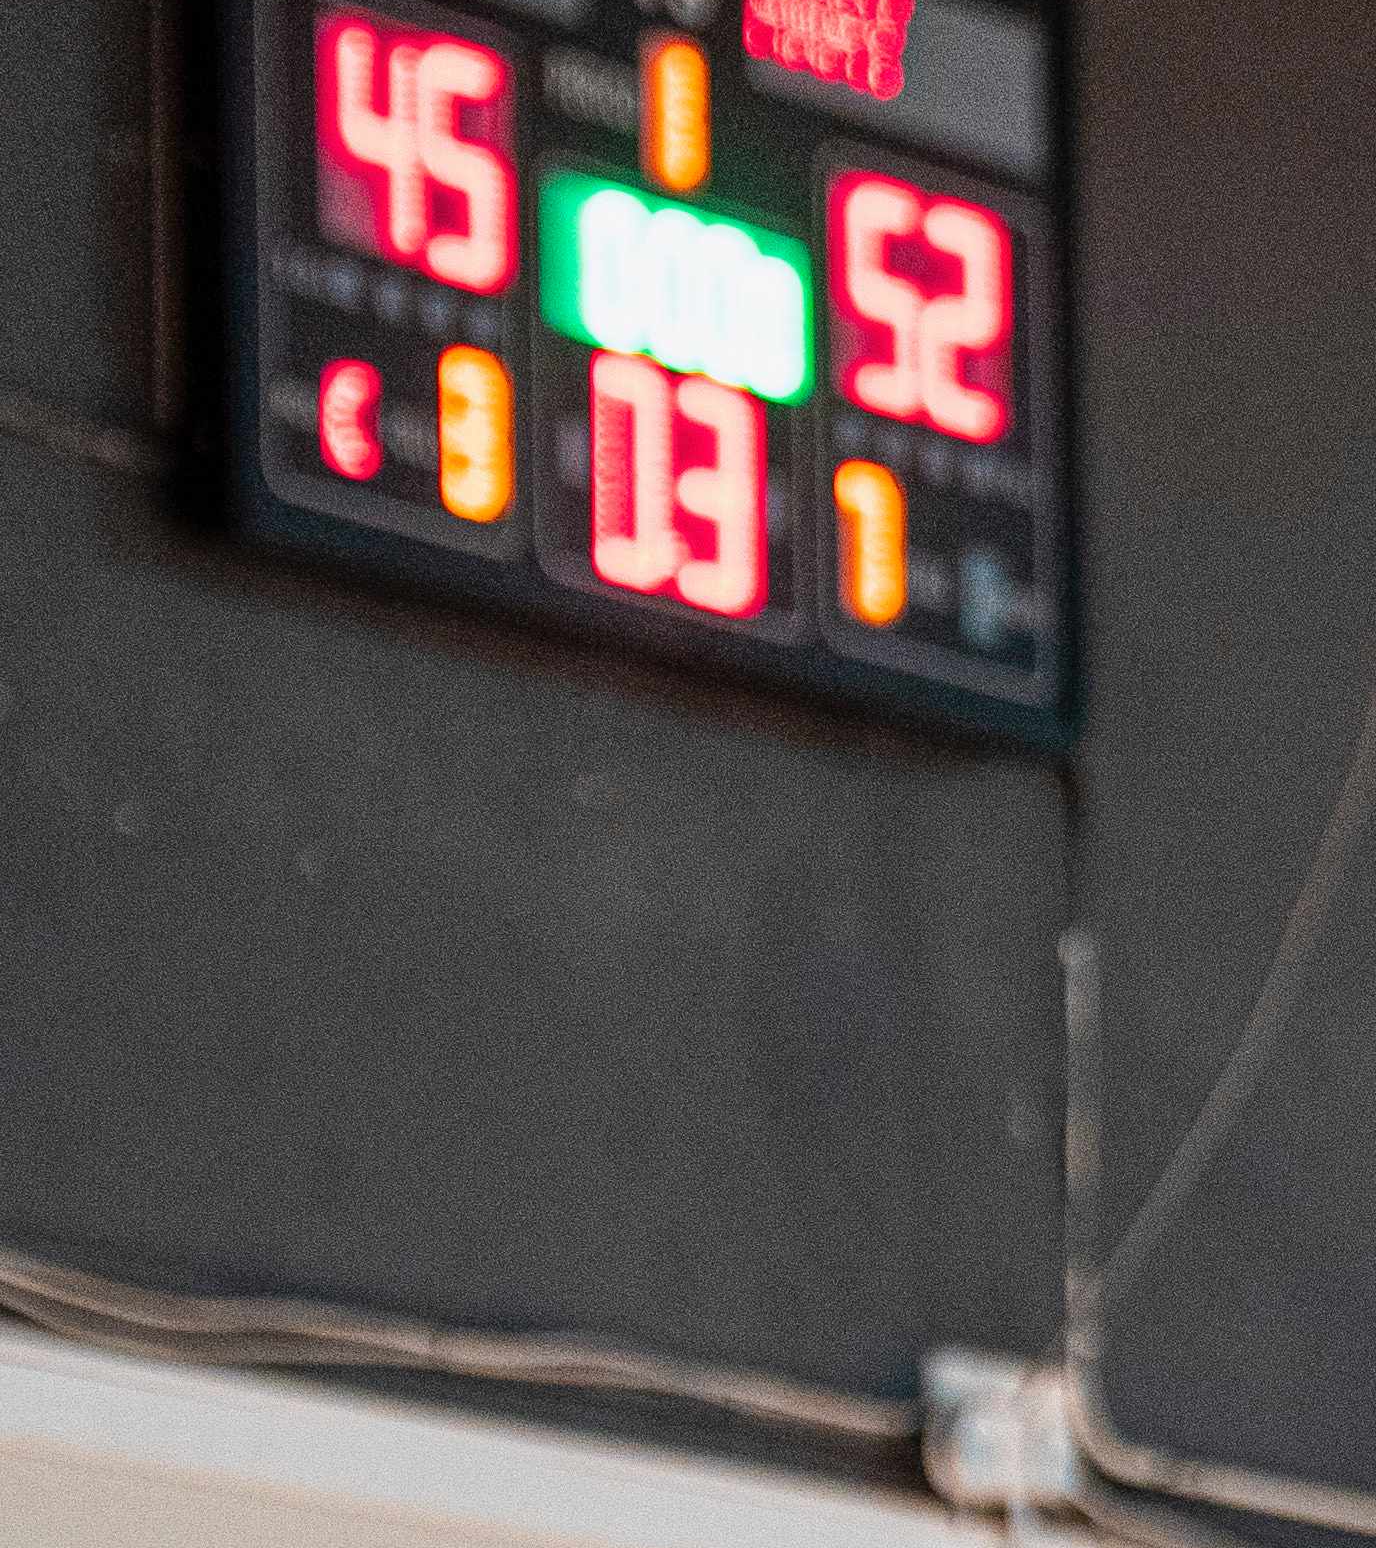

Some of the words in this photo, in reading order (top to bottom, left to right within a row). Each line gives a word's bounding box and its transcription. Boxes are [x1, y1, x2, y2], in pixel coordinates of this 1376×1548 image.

[325, 8, 516, 296] 45
[832, 169, 1014, 445] 52
[833, 456, 908, 628] 1
